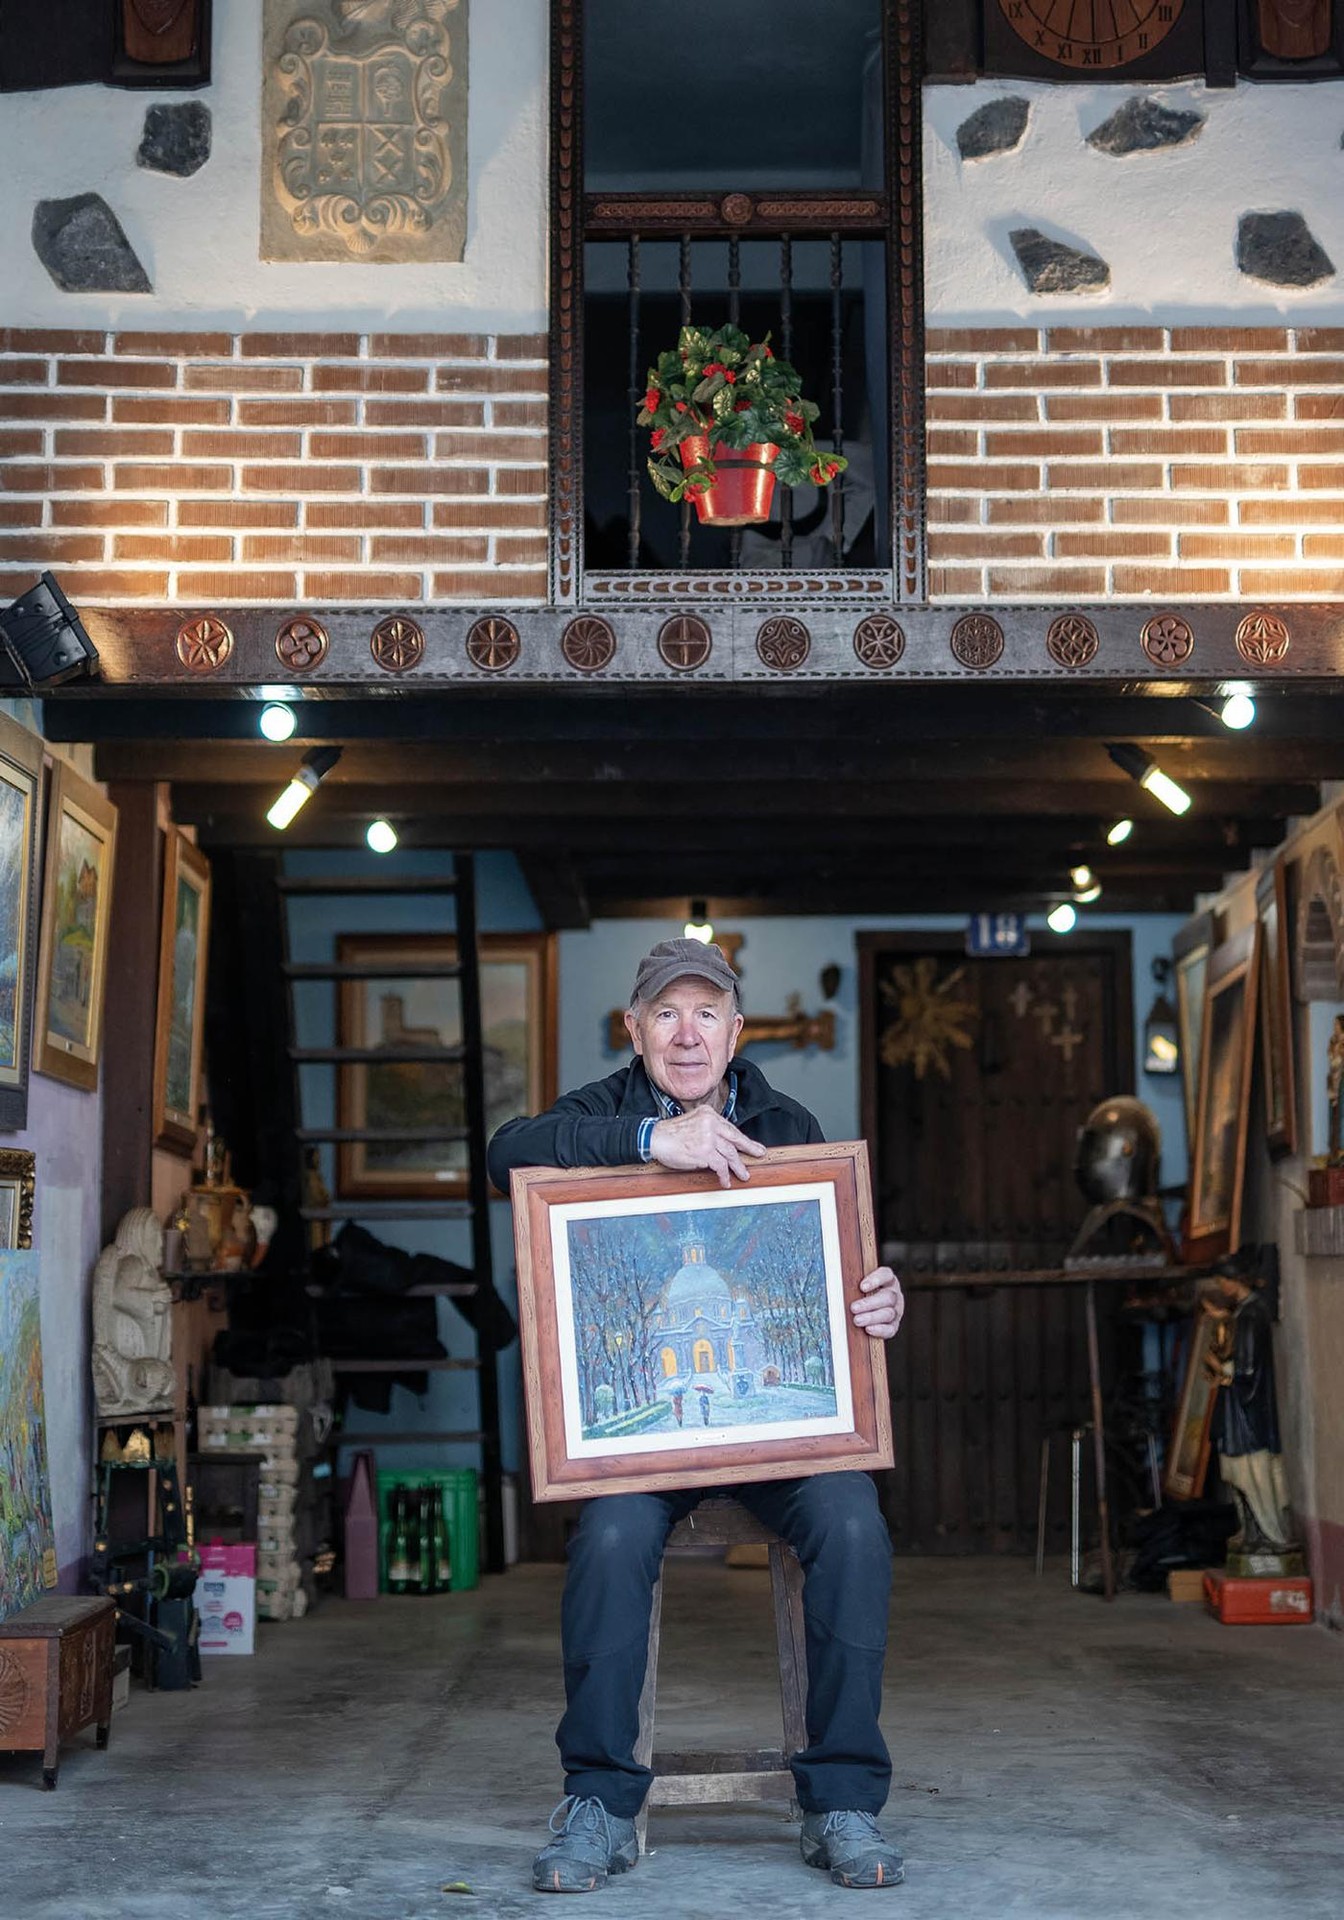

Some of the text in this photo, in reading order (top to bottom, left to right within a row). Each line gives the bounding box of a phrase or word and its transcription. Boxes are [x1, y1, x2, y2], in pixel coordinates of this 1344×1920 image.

[1158, 5, 1173, 22] III
[1033, 29, 1046, 46] X
[1138, 33, 1148, 50] II
[1056, 42, 1073, 59] XI
[1081, 47, 1102, 64] XII
